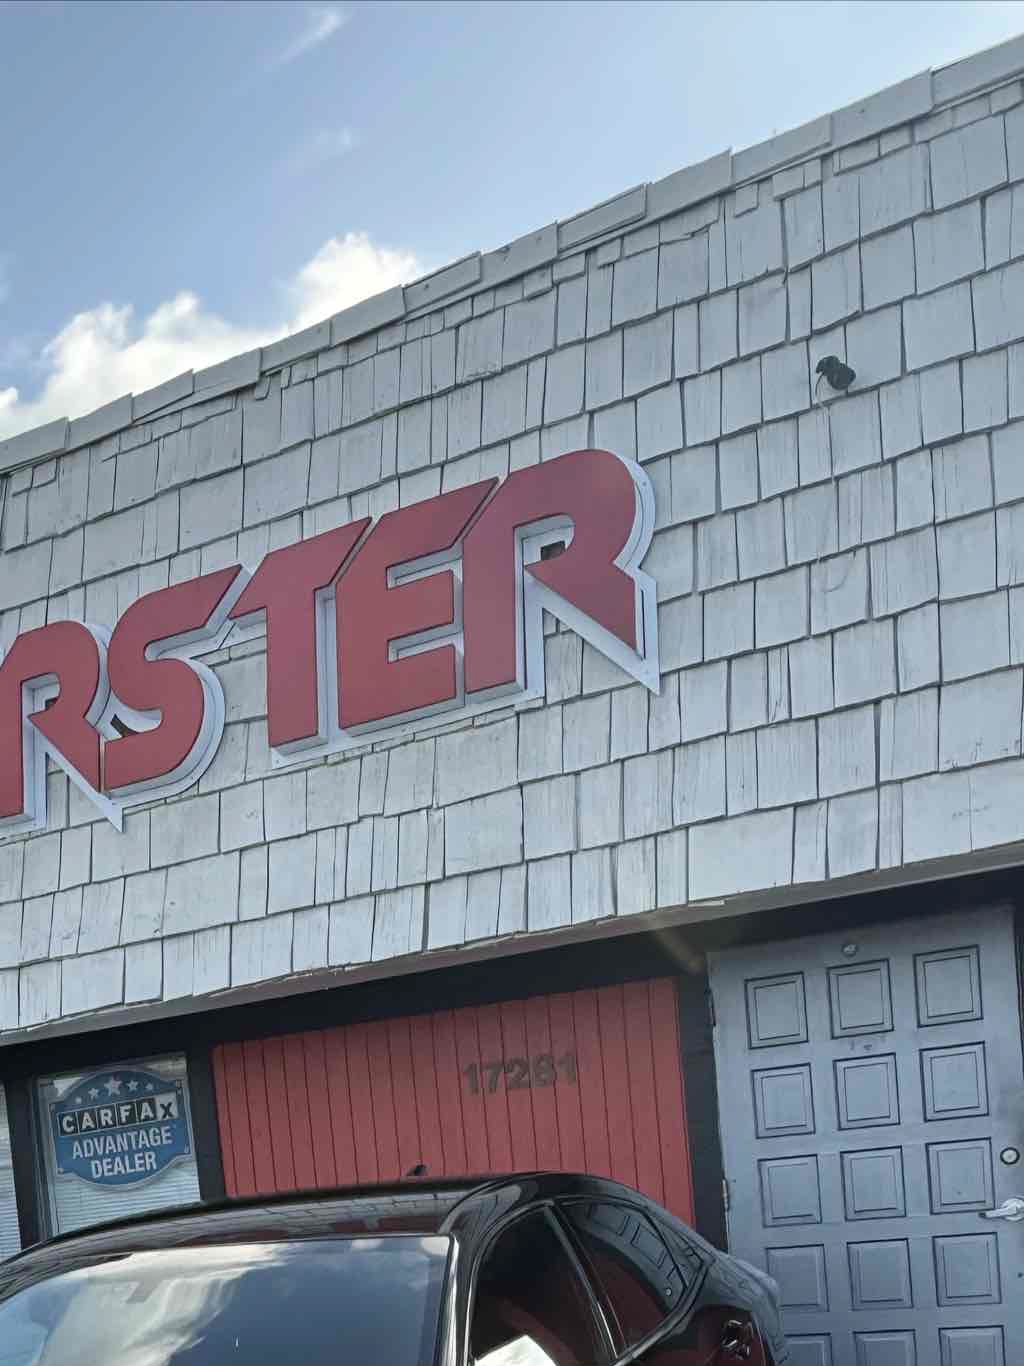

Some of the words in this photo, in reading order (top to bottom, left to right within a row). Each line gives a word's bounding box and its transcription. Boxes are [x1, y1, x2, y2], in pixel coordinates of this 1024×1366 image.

[463, 1054, 577, 1095] 17281
[61, 1100, 174, 1134] CARFAX
[72, 1125, 173, 1160] ADVANTAGE
[91, 1151, 158, 1179] DEALER
